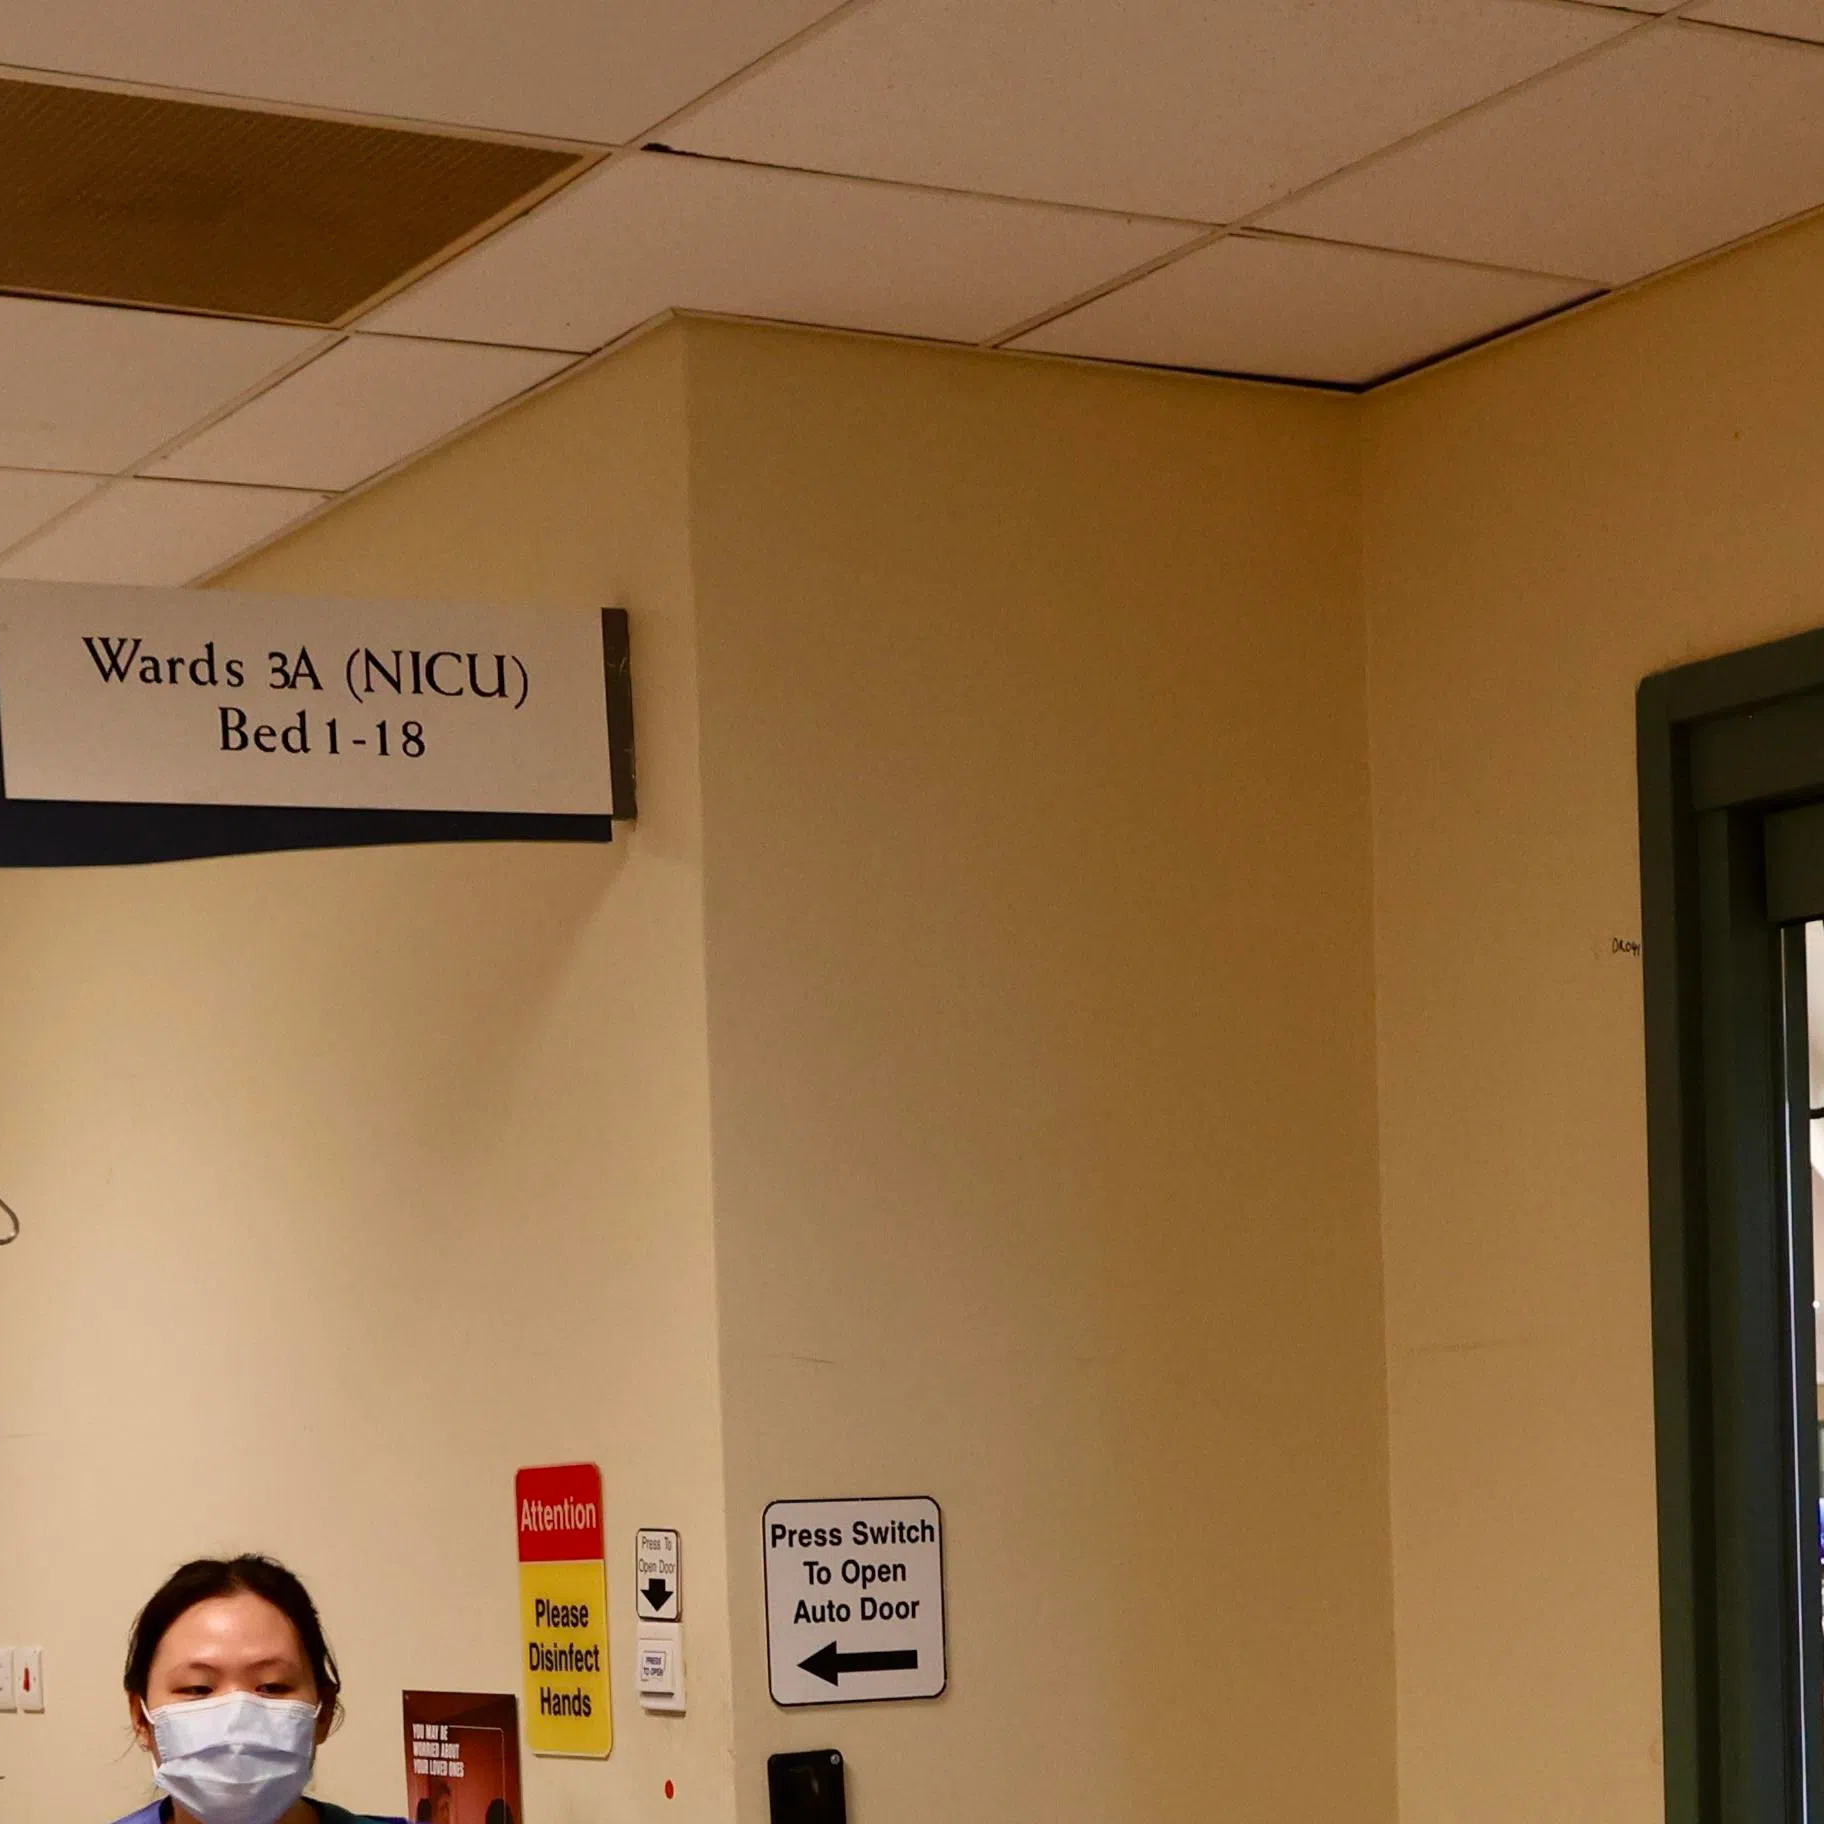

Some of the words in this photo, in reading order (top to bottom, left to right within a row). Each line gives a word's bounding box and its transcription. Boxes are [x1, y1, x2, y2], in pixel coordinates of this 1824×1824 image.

[82, 636, 245, 685] Wards
[268, 646, 323, 691] 3A
[346, 647, 529, 709] (NICU)
[219, 706, 311, 754] Bed
[327, 718, 427, 758] 1-18
[520, 1496, 597, 1532] Attention
[641, 1536, 661, 1551] Press
[771, 1523, 842, 1548] Press
[852, 1519, 935, 1546] Switch
[803, 1561, 832, 1585] To
[841, 1559, 906, 1589] Open
[535, 1598, 589, 1628] Please
[793, 1599, 851, 1624] Auto
[860, 1597, 920, 1621] Door
[529, 1642, 600, 1673] Disinfect
[540, 1686, 592, 1718] Hands
